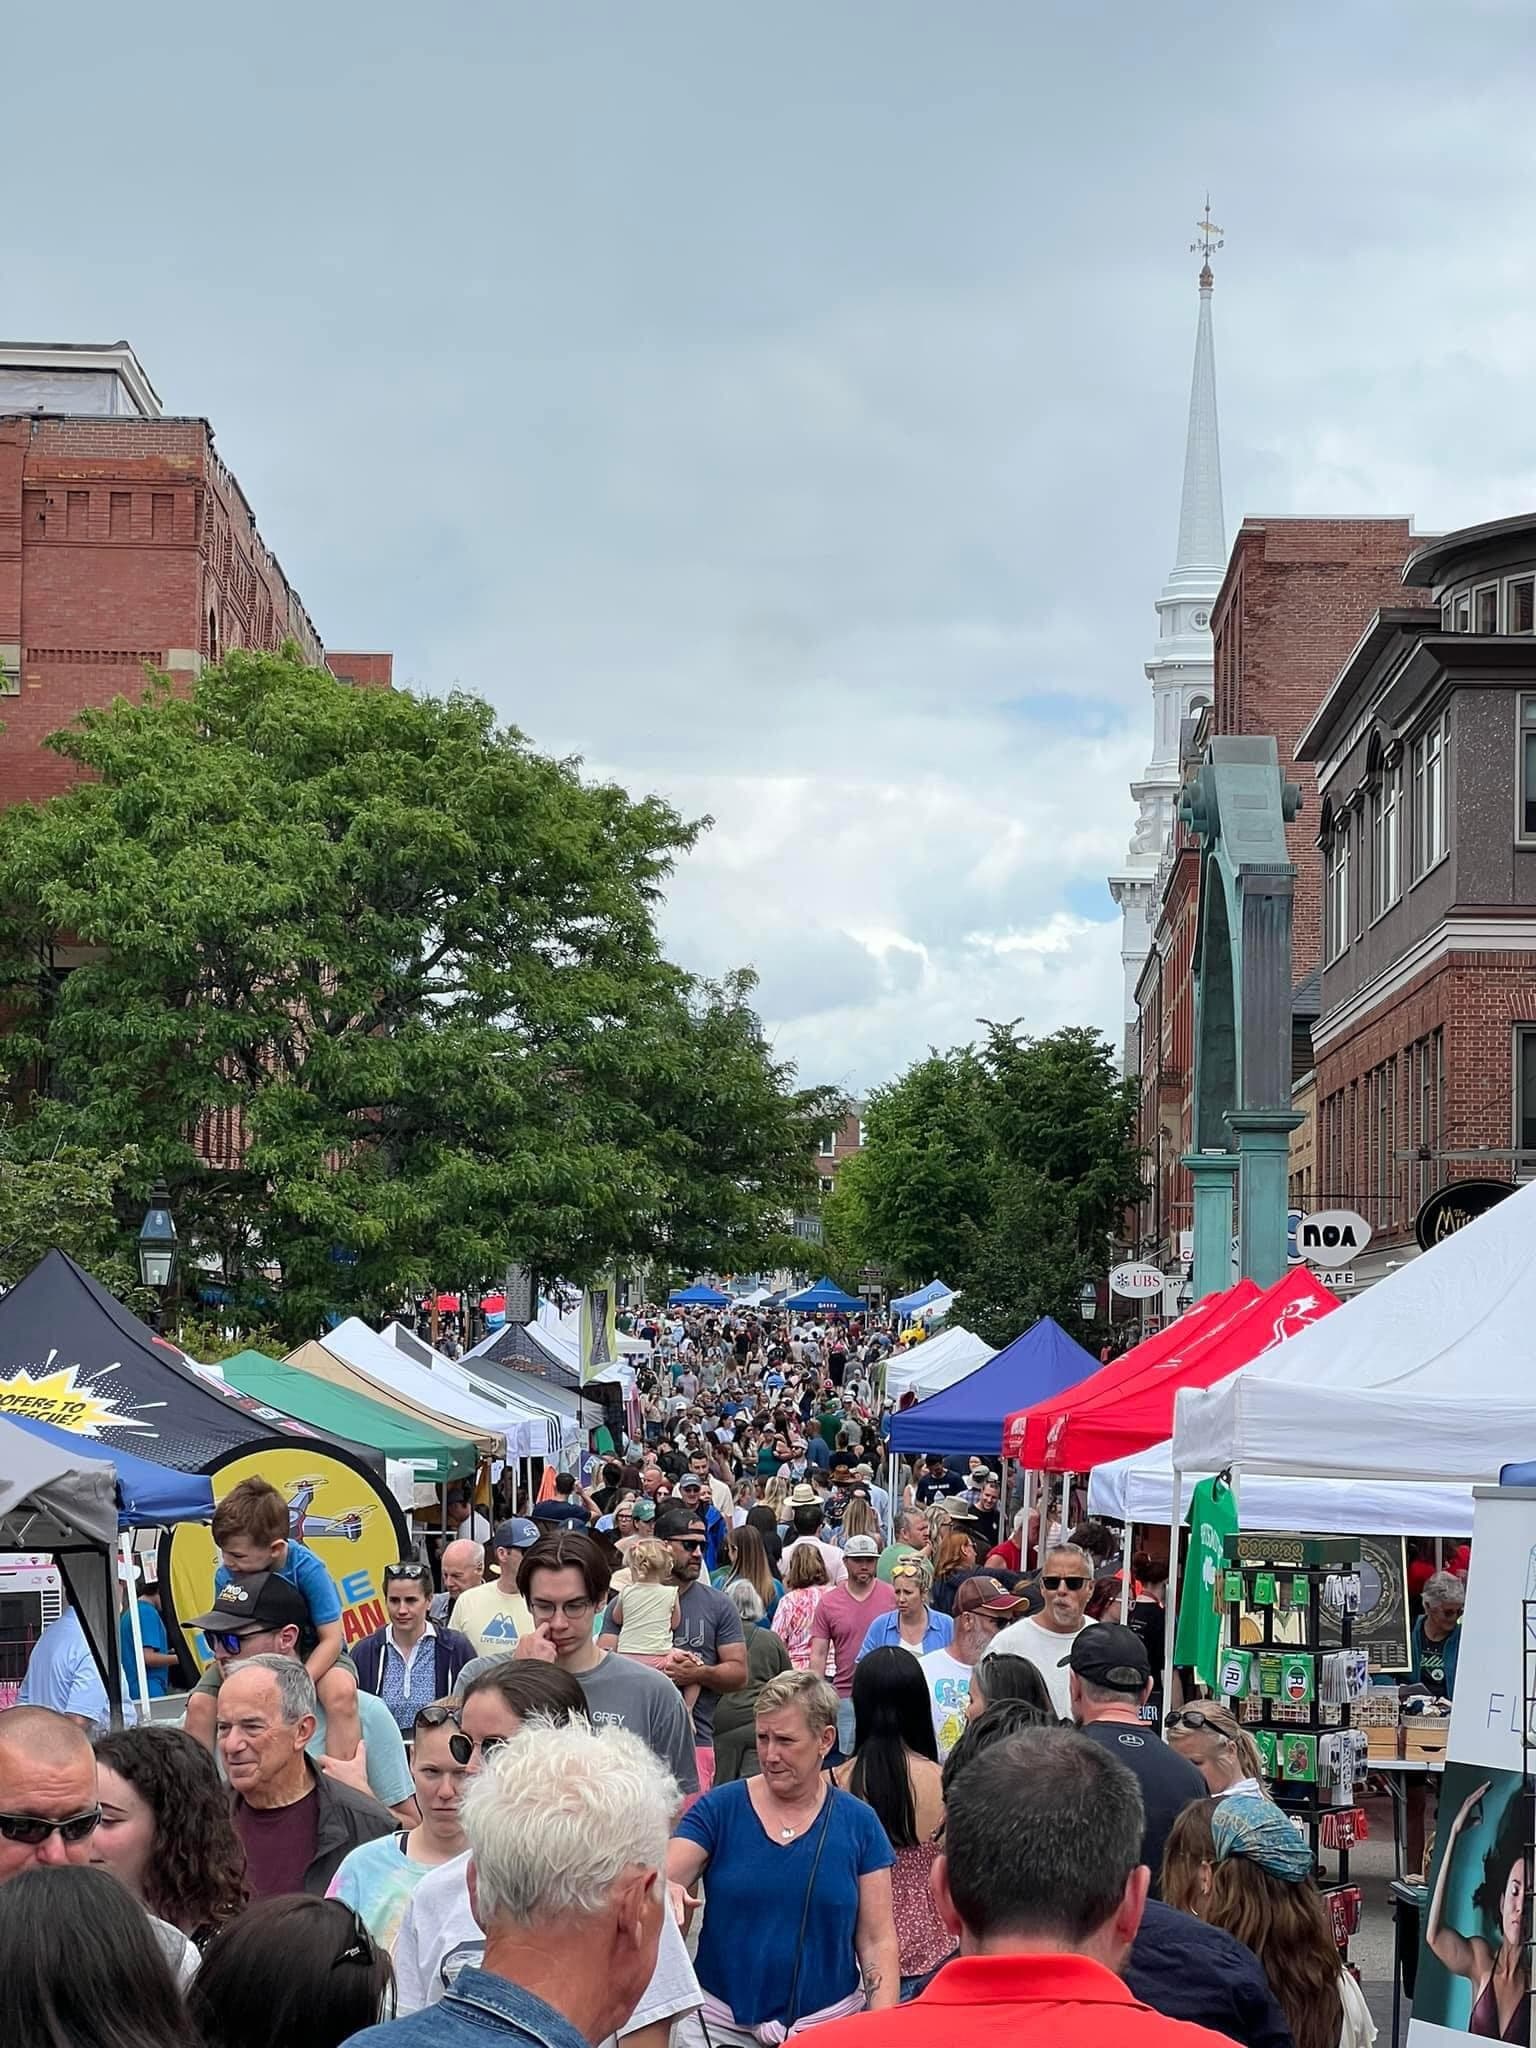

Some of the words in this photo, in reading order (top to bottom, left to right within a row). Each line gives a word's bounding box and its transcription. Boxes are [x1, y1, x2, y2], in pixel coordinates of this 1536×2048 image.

[1133, 1275, 1160, 1288] UBS
[0, 1394, 58, 1409] OFERS
[61, 1401, 86, 1413] TO
[1225, 1667, 1240, 1688] IRL
[592, 1711, 625, 1727] GREY
